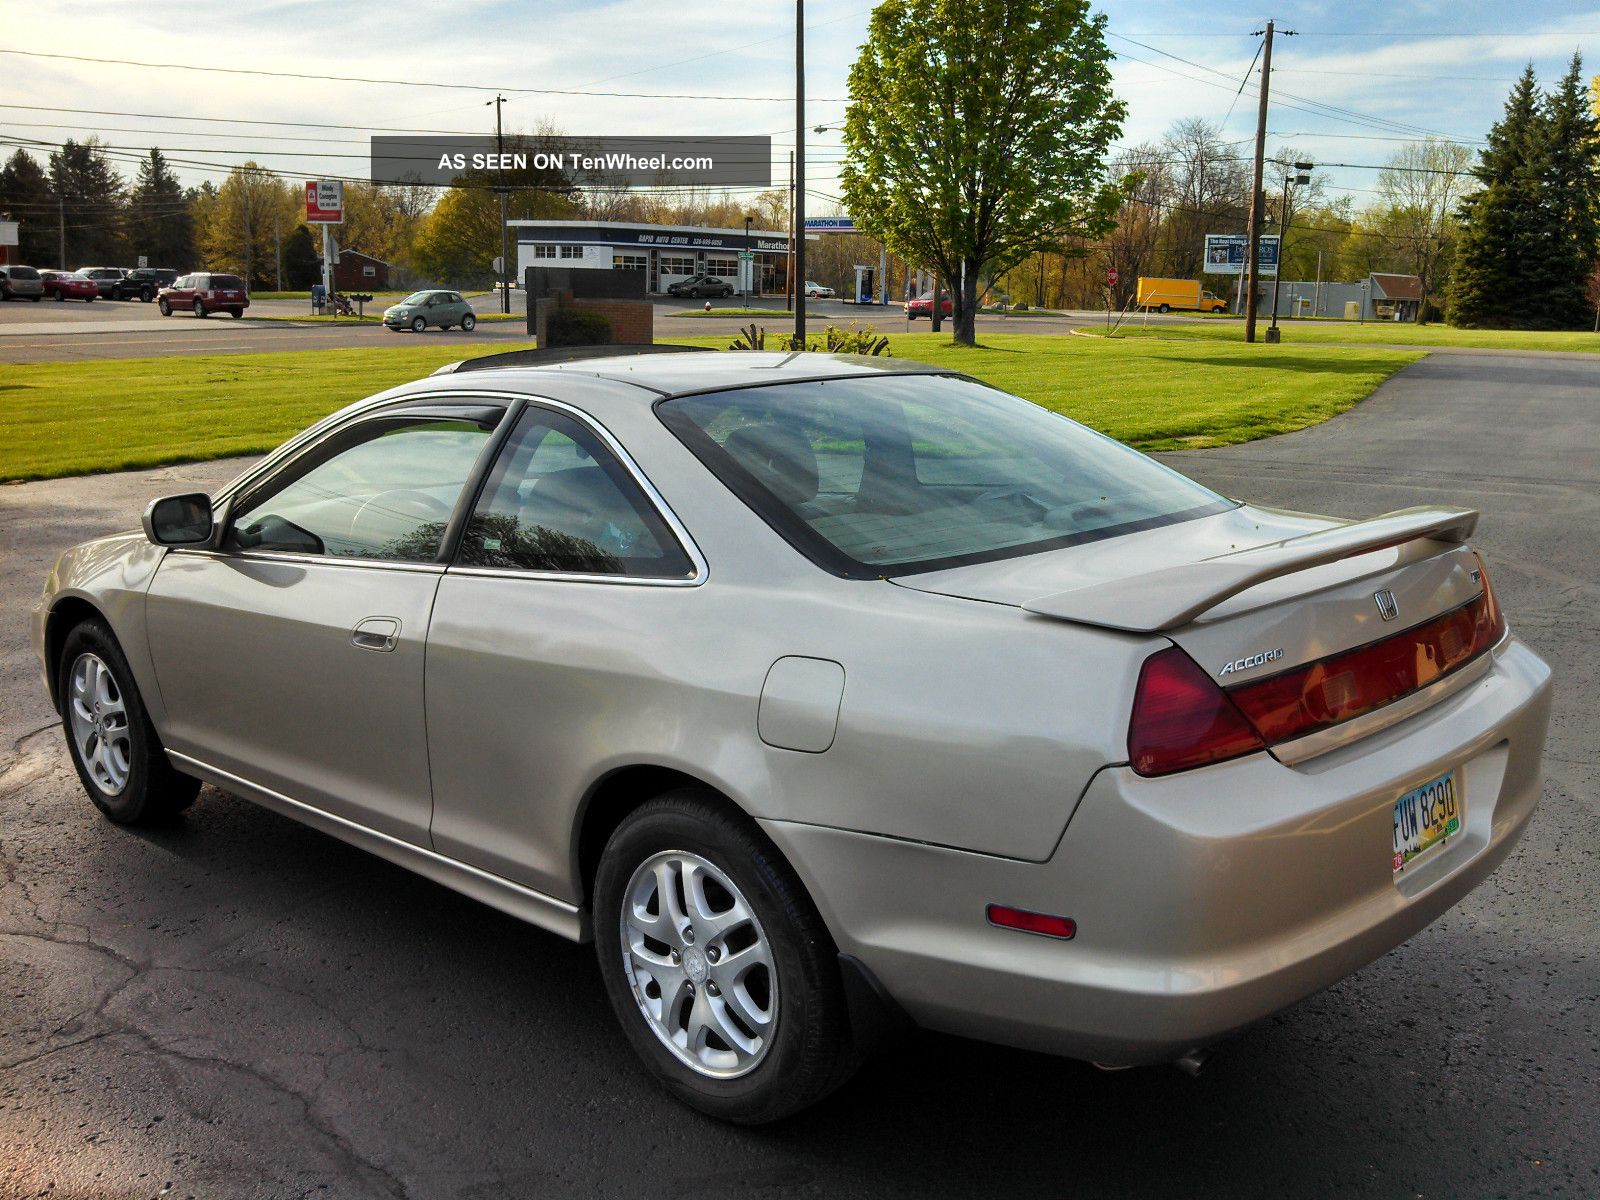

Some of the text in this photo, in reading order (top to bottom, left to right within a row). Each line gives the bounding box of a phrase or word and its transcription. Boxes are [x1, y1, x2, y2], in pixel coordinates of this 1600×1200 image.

[804, 219, 838, 228] MARATHON
[655, 235, 670, 244] AUTO
[670, 236, 689, 245] CENTER
[757, 239, 789, 250] Maratho
[1218, 648, 1284, 677] ACCORD
[1394, 778, 1455, 848] FUW 8290
